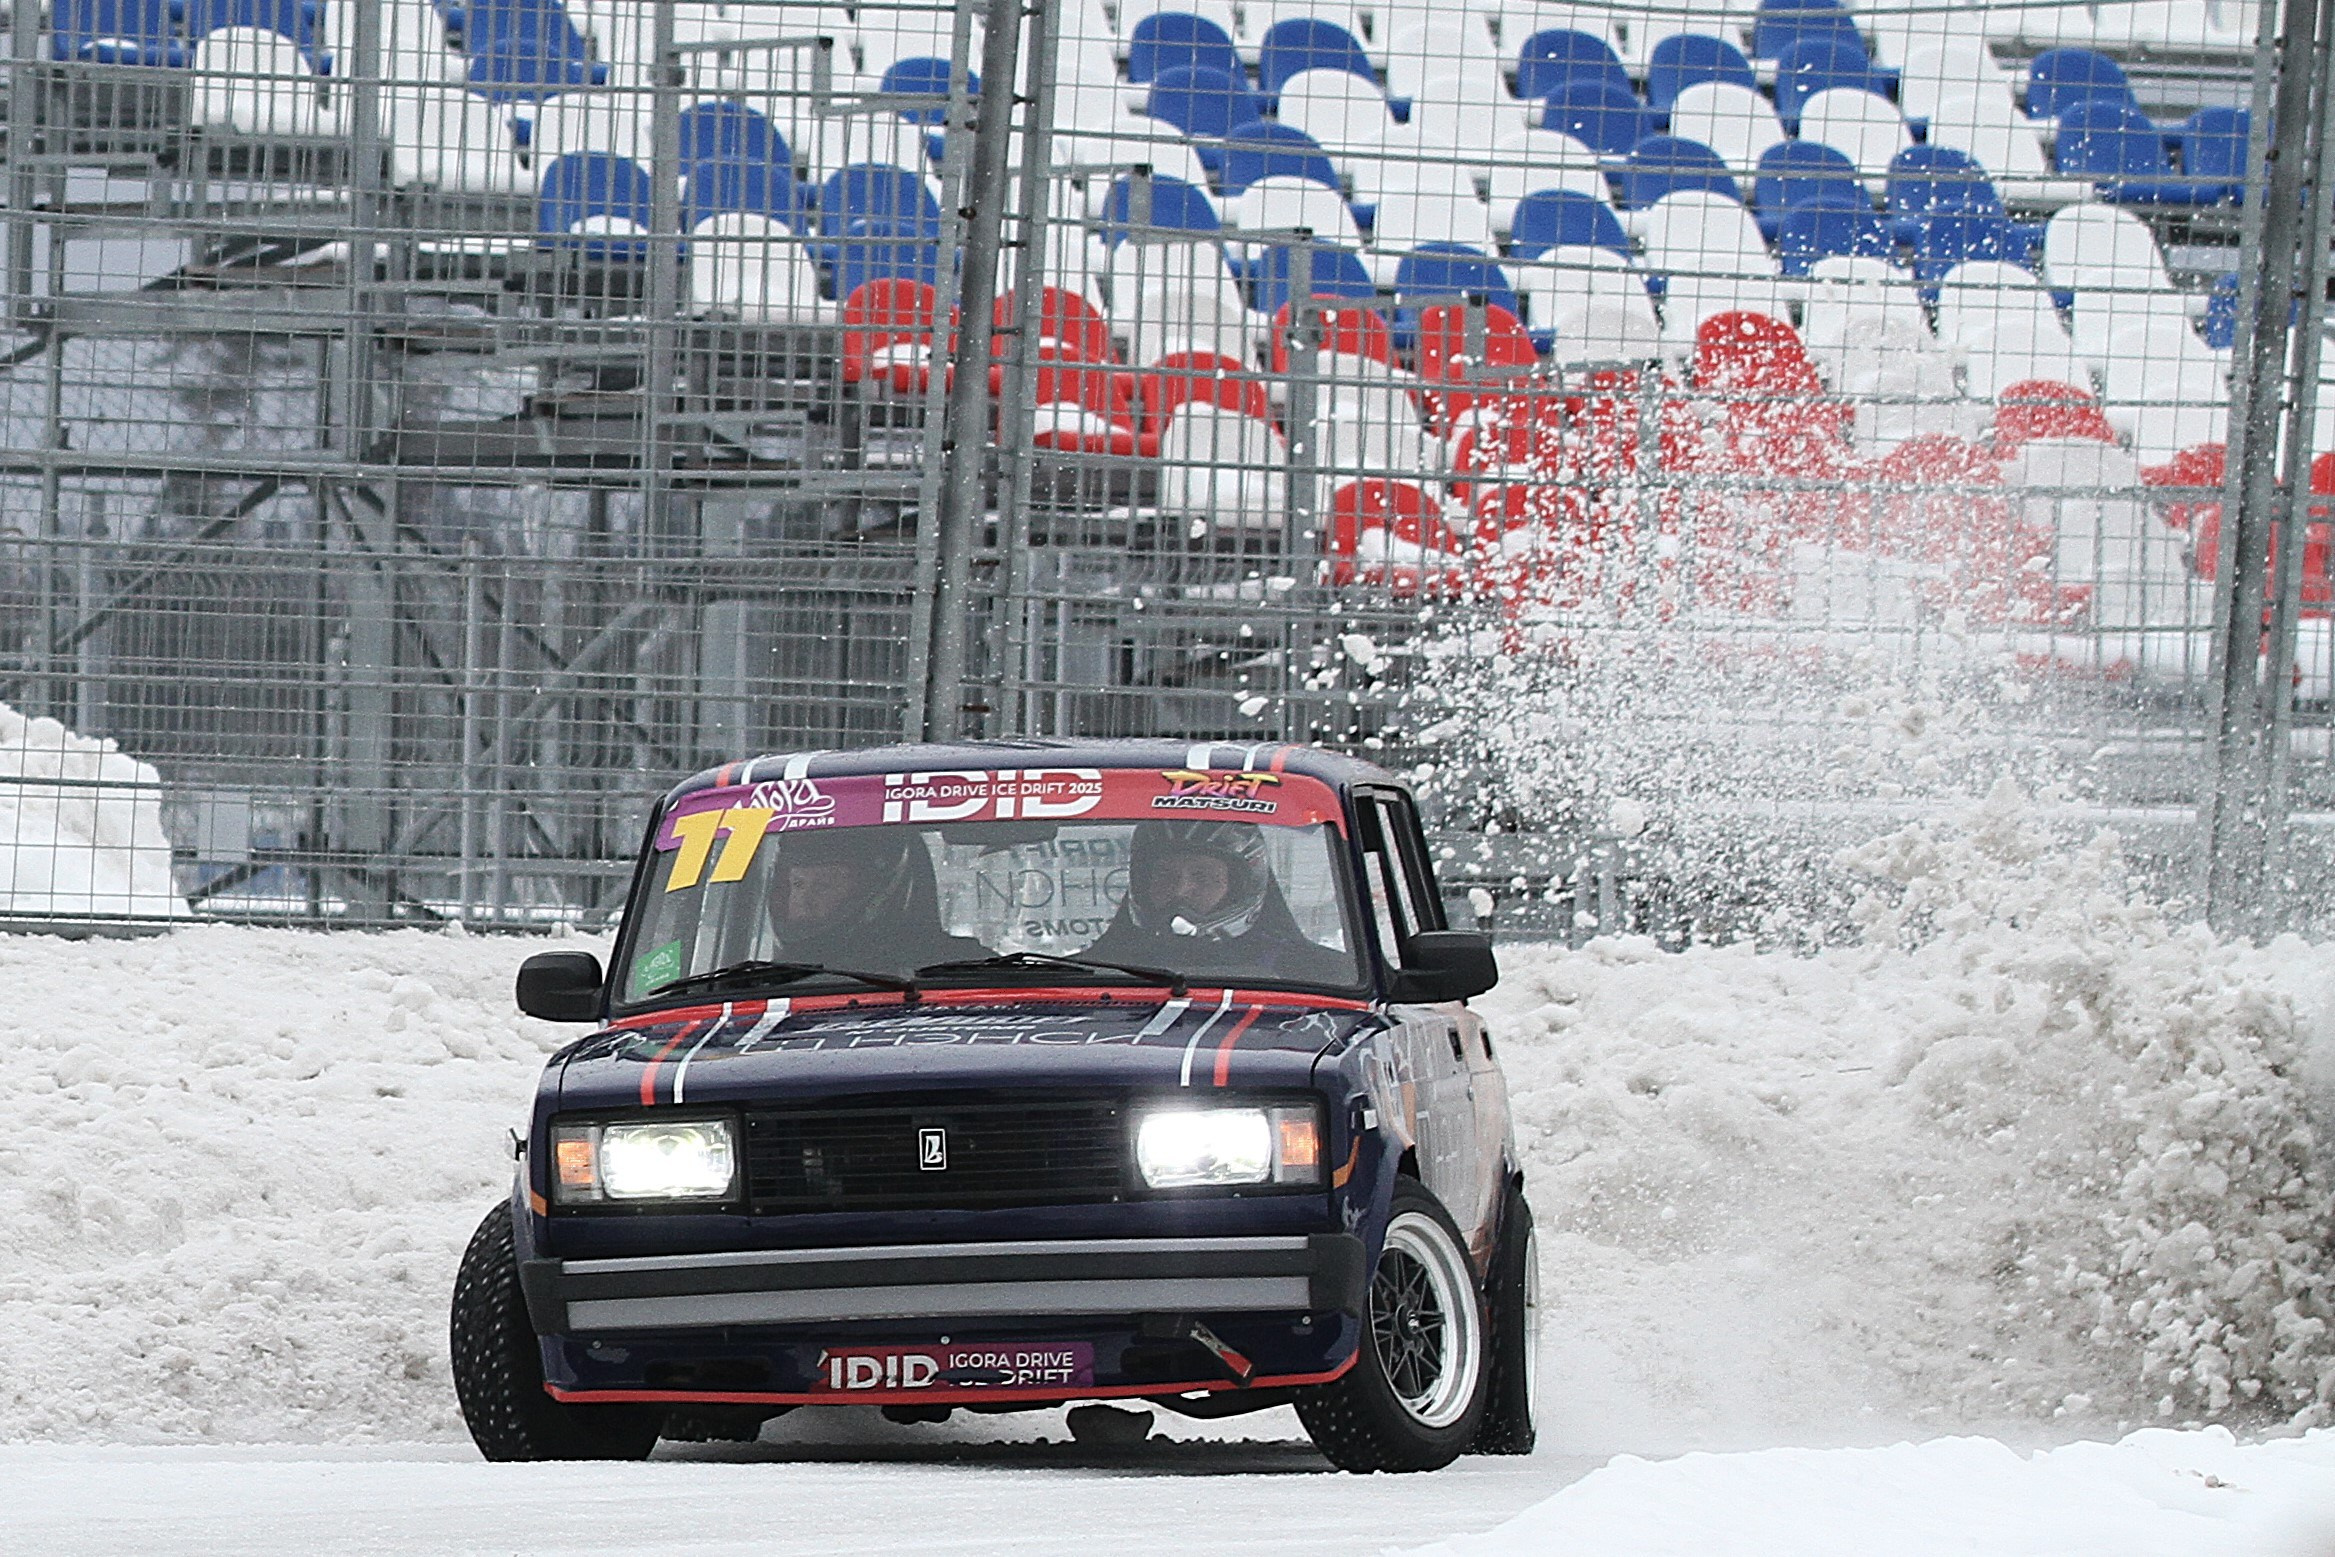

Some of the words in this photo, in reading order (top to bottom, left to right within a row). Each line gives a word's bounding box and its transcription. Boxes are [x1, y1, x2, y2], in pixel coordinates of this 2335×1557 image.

[882, 768, 1102, 823] IDID
[885, 787, 937, 800] IGORA
[940, 784, 987, 798] DRIVE
[991, 783, 1017, 796] ICE
[1021, 782, 1065, 795] DRIFT
[1068, 781, 1102, 795] 2025
[1152, 796, 1277, 814] MATSURI
[788, 816, 835, 828] ДРАЙВ
[665, 808, 776, 893] 11
[950, 1353, 1010, 1369] IGORA
[1015, 1351, 1073, 1368] DRIVE
[830, 1353, 939, 1389] IDID
